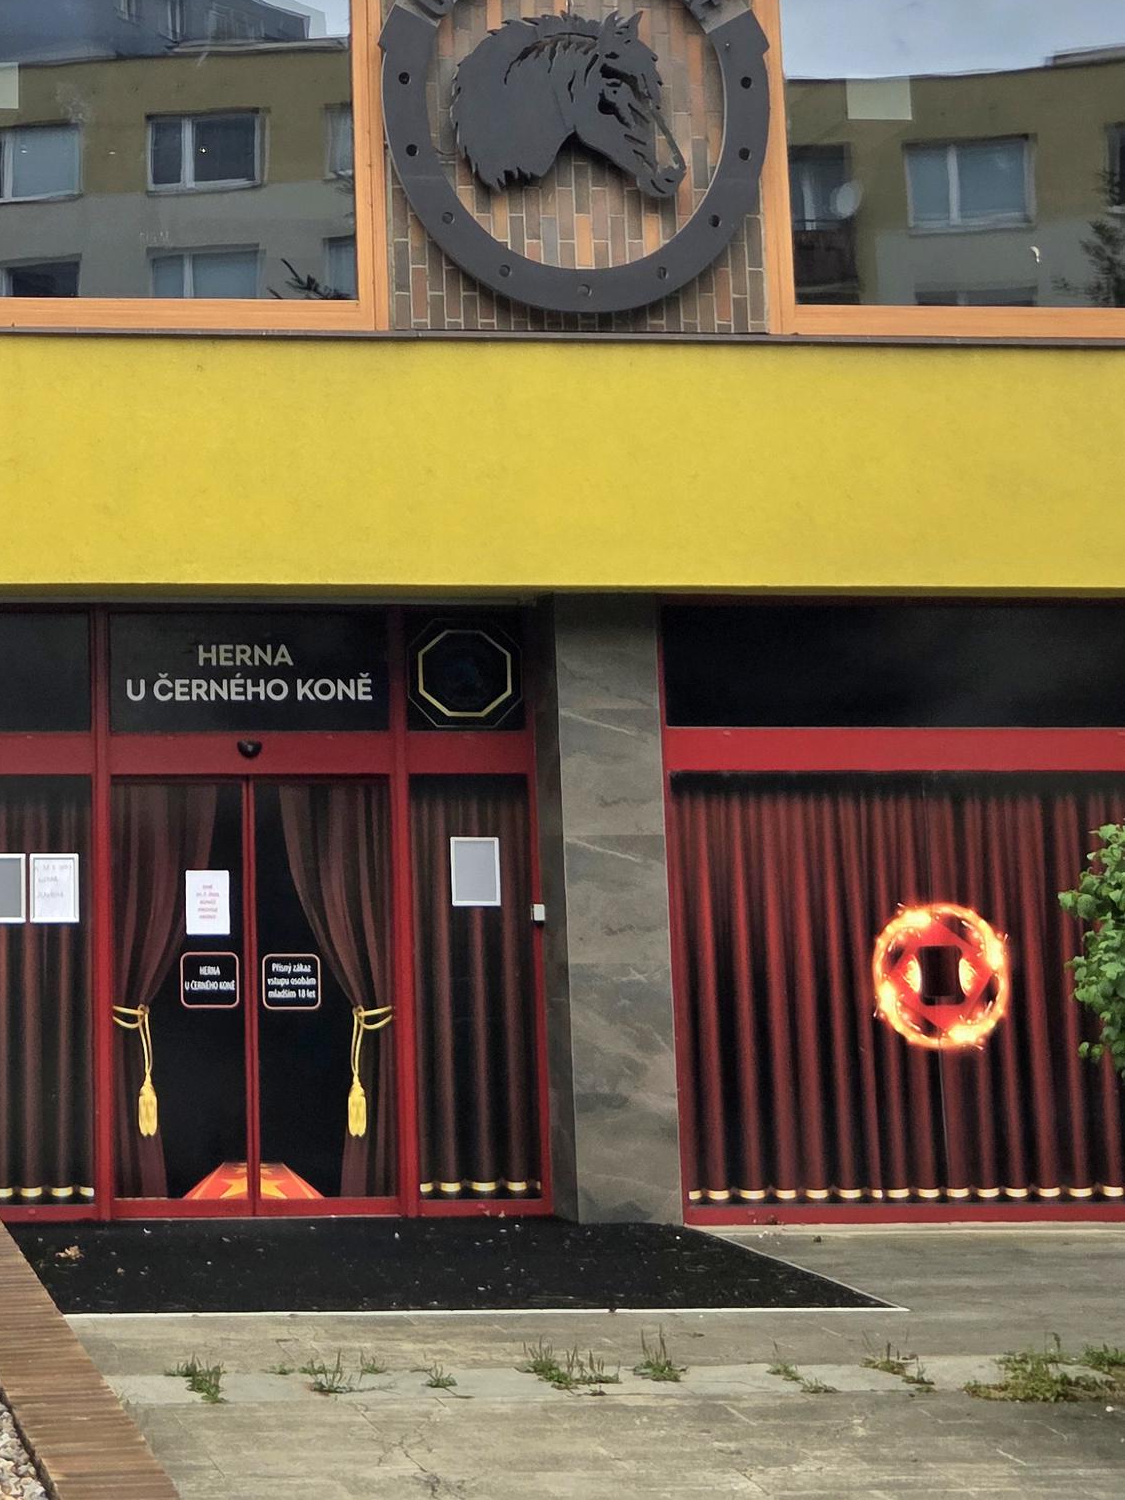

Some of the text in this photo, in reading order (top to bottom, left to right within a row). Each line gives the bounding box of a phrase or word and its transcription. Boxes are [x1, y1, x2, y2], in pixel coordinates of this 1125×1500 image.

[198, 644, 294, 667] HERNA
[126, 672, 373, 701] U ČERNÉHO KONĚ
